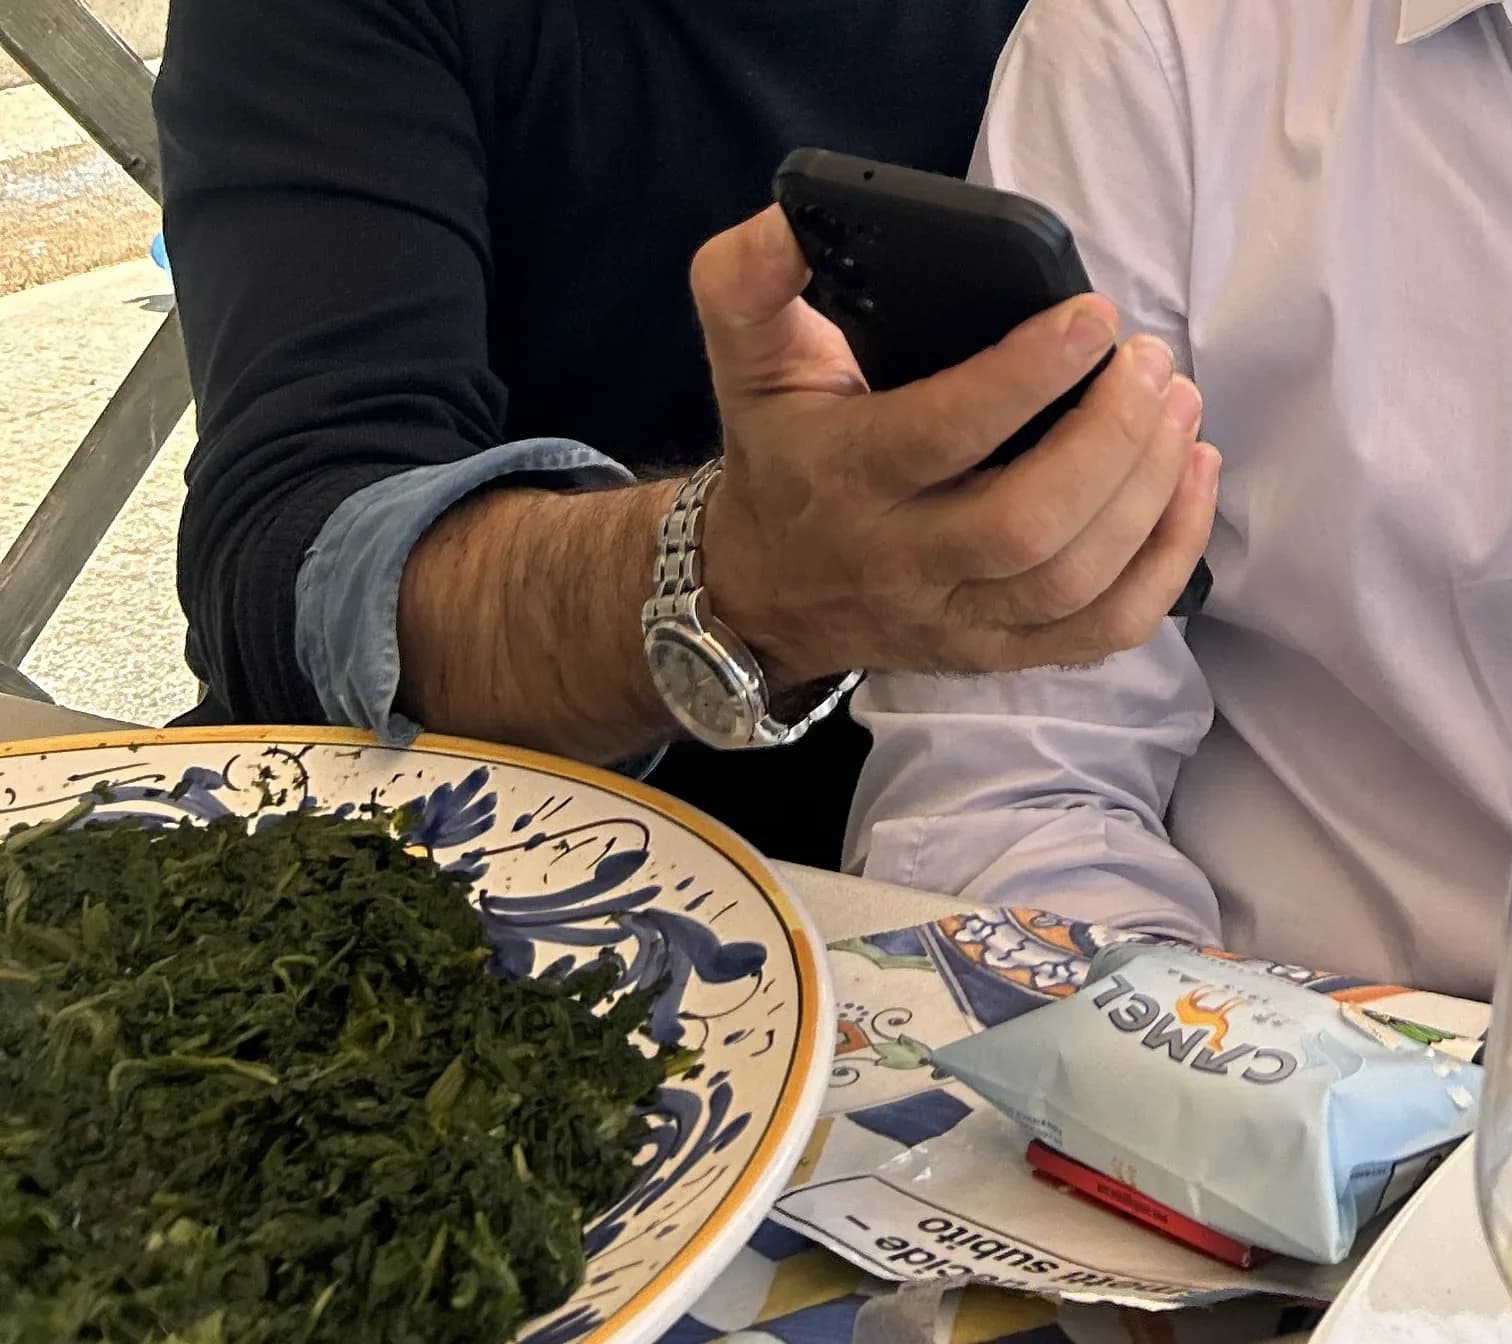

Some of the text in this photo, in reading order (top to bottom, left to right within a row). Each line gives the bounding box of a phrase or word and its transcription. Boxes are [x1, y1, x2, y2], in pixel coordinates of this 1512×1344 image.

[1092, 974, 1298, 1086] CAMEL
[875, 1234, 1029, 1288] cide
[917, 1216, 1060, 1274] subito
